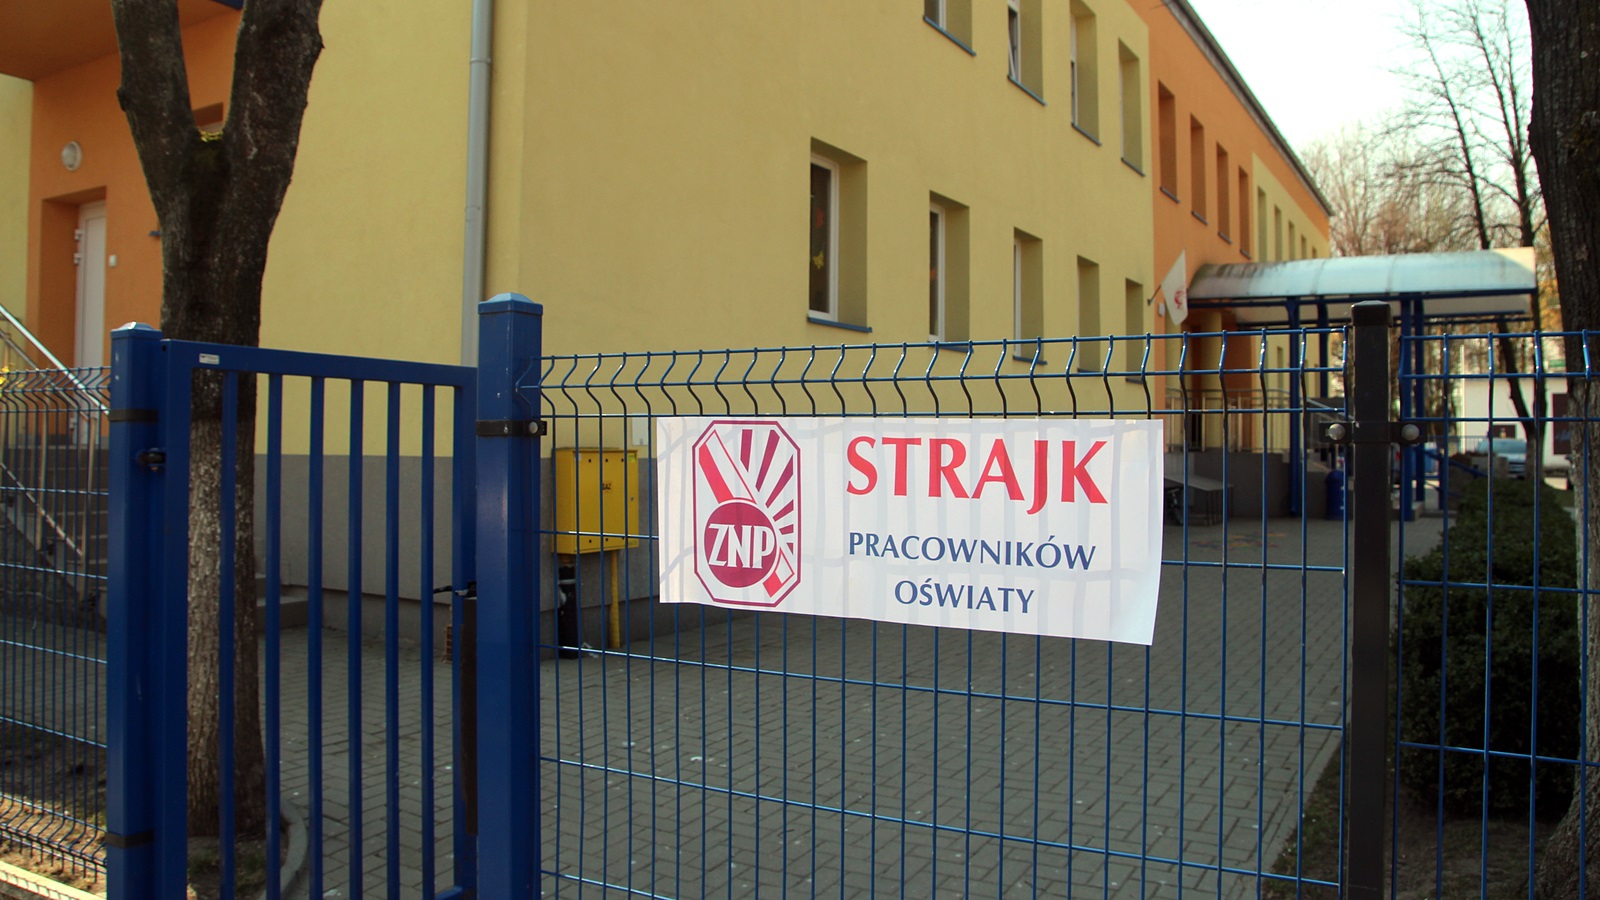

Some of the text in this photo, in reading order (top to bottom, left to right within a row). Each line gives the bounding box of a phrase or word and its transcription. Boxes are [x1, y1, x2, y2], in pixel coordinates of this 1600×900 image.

[846, 435, 1108, 515] STRAJK
[708, 523, 776, 569] ZNP
[848, 531, 1097, 571] PRACOWNIKÓW
[894, 578, 1035, 614] OŚWIATY
